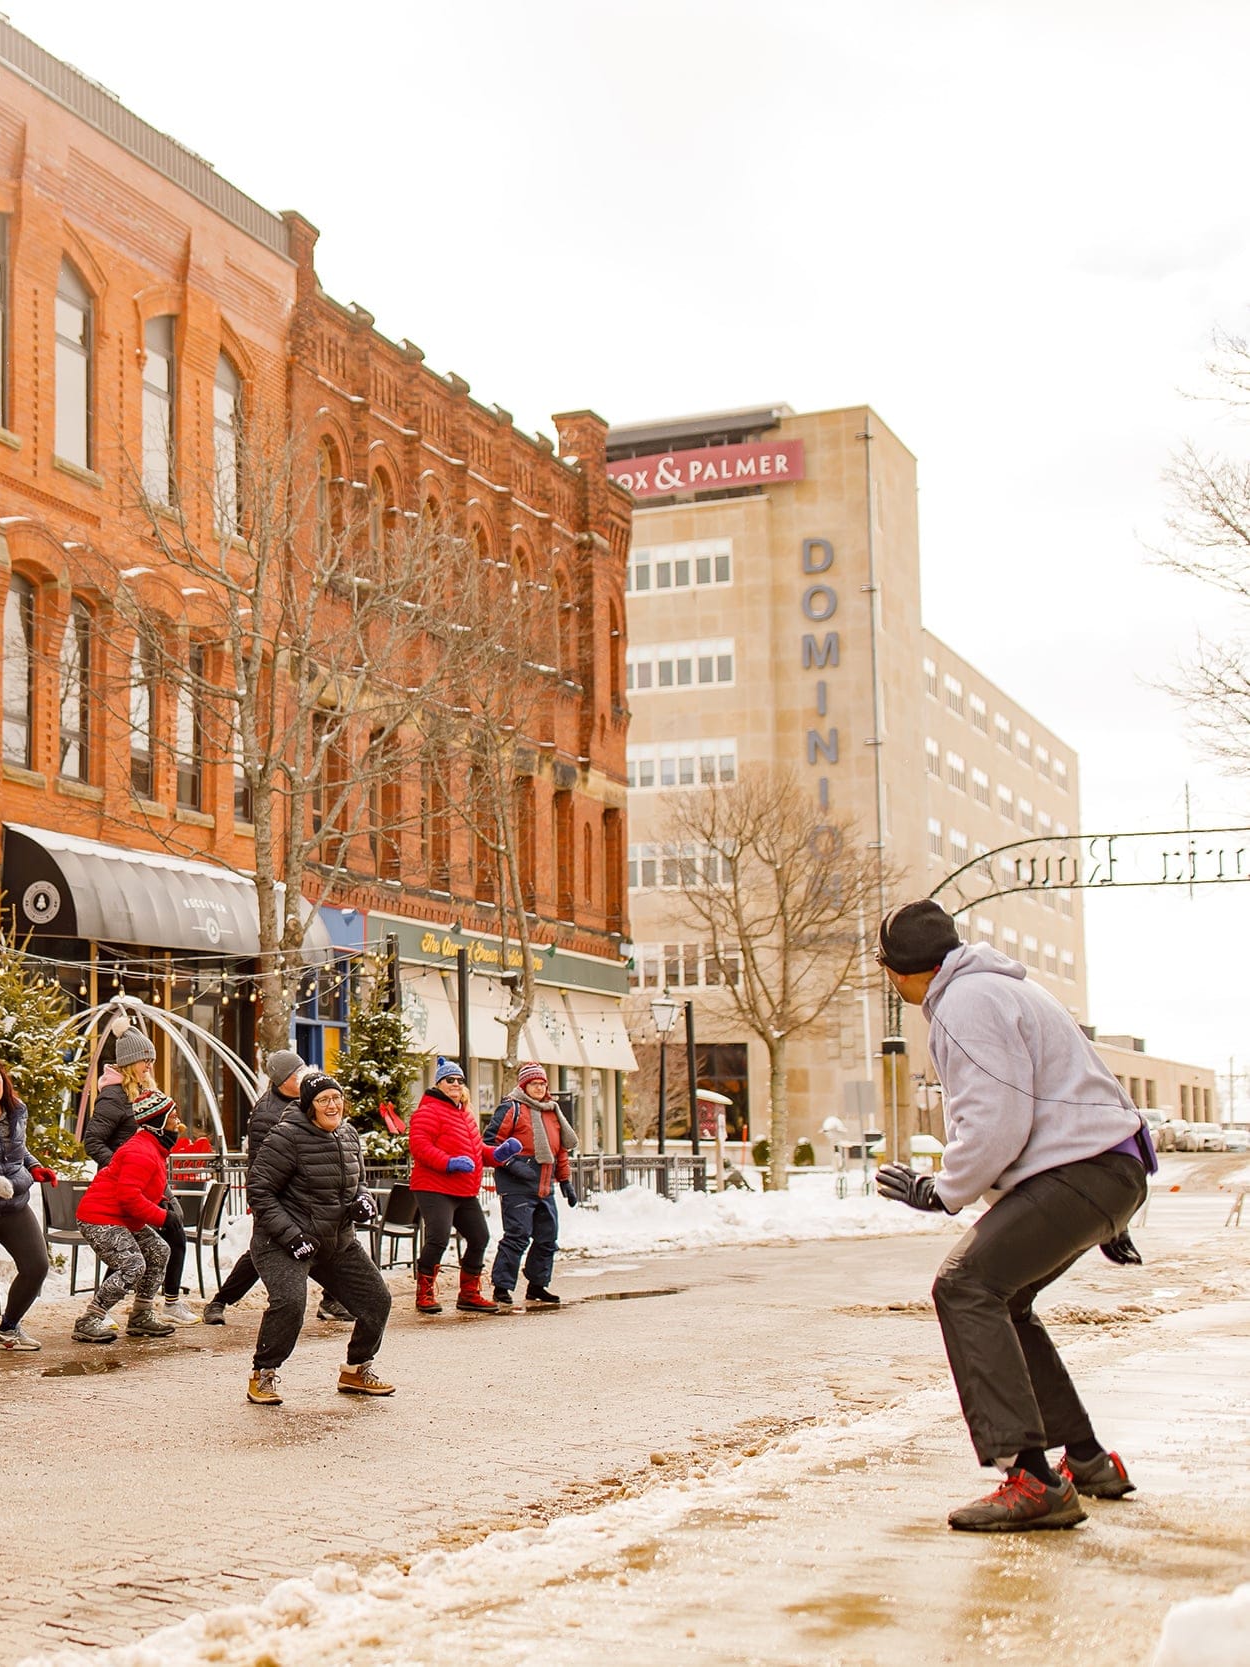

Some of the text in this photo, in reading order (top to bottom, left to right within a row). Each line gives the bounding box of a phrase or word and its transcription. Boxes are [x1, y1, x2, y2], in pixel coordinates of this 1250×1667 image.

[606, 453, 790, 491] OX & PALMER
[420, 931, 440, 954] The
[441, 935, 464, 957] Ann
